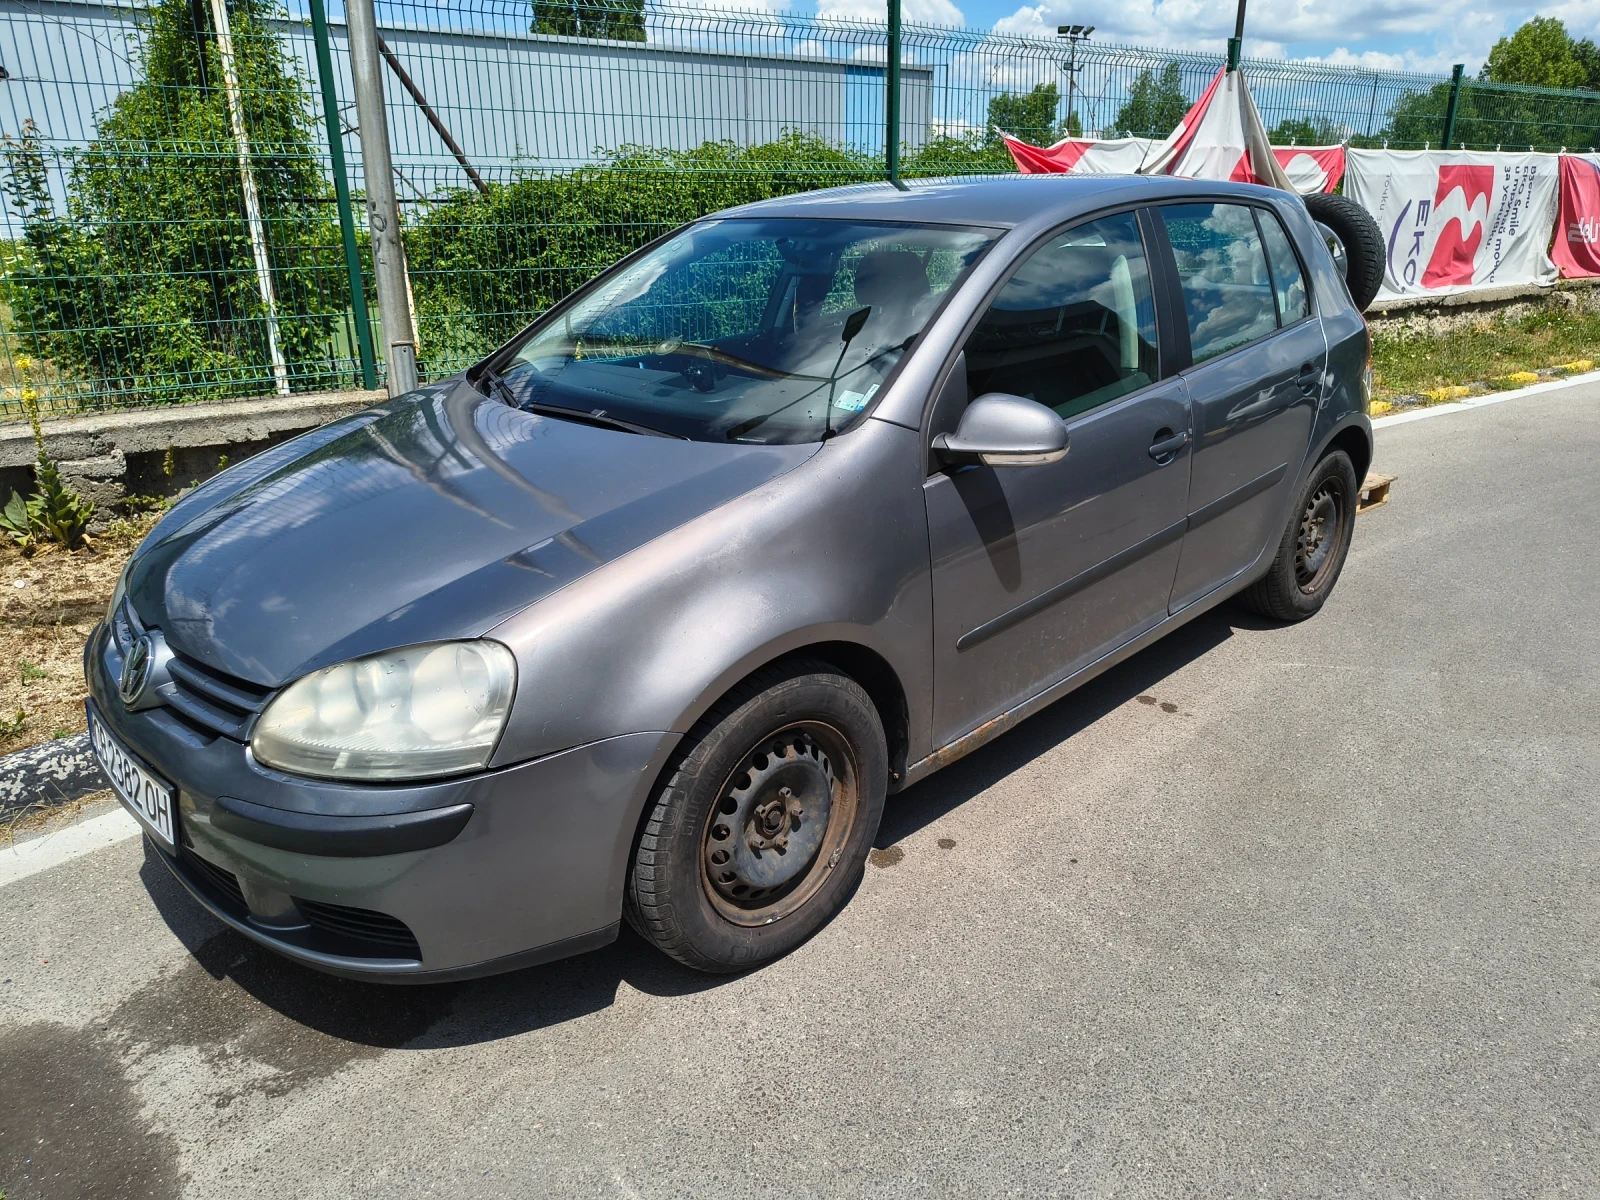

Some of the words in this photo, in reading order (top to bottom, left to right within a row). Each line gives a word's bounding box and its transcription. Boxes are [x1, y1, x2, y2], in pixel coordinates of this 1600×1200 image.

[1403, 200, 1430, 286] EKO
[1509, 199, 1522, 236] Smile
[108, 739, 143, 810] 2382
[145, 779, 170, 836] OH
